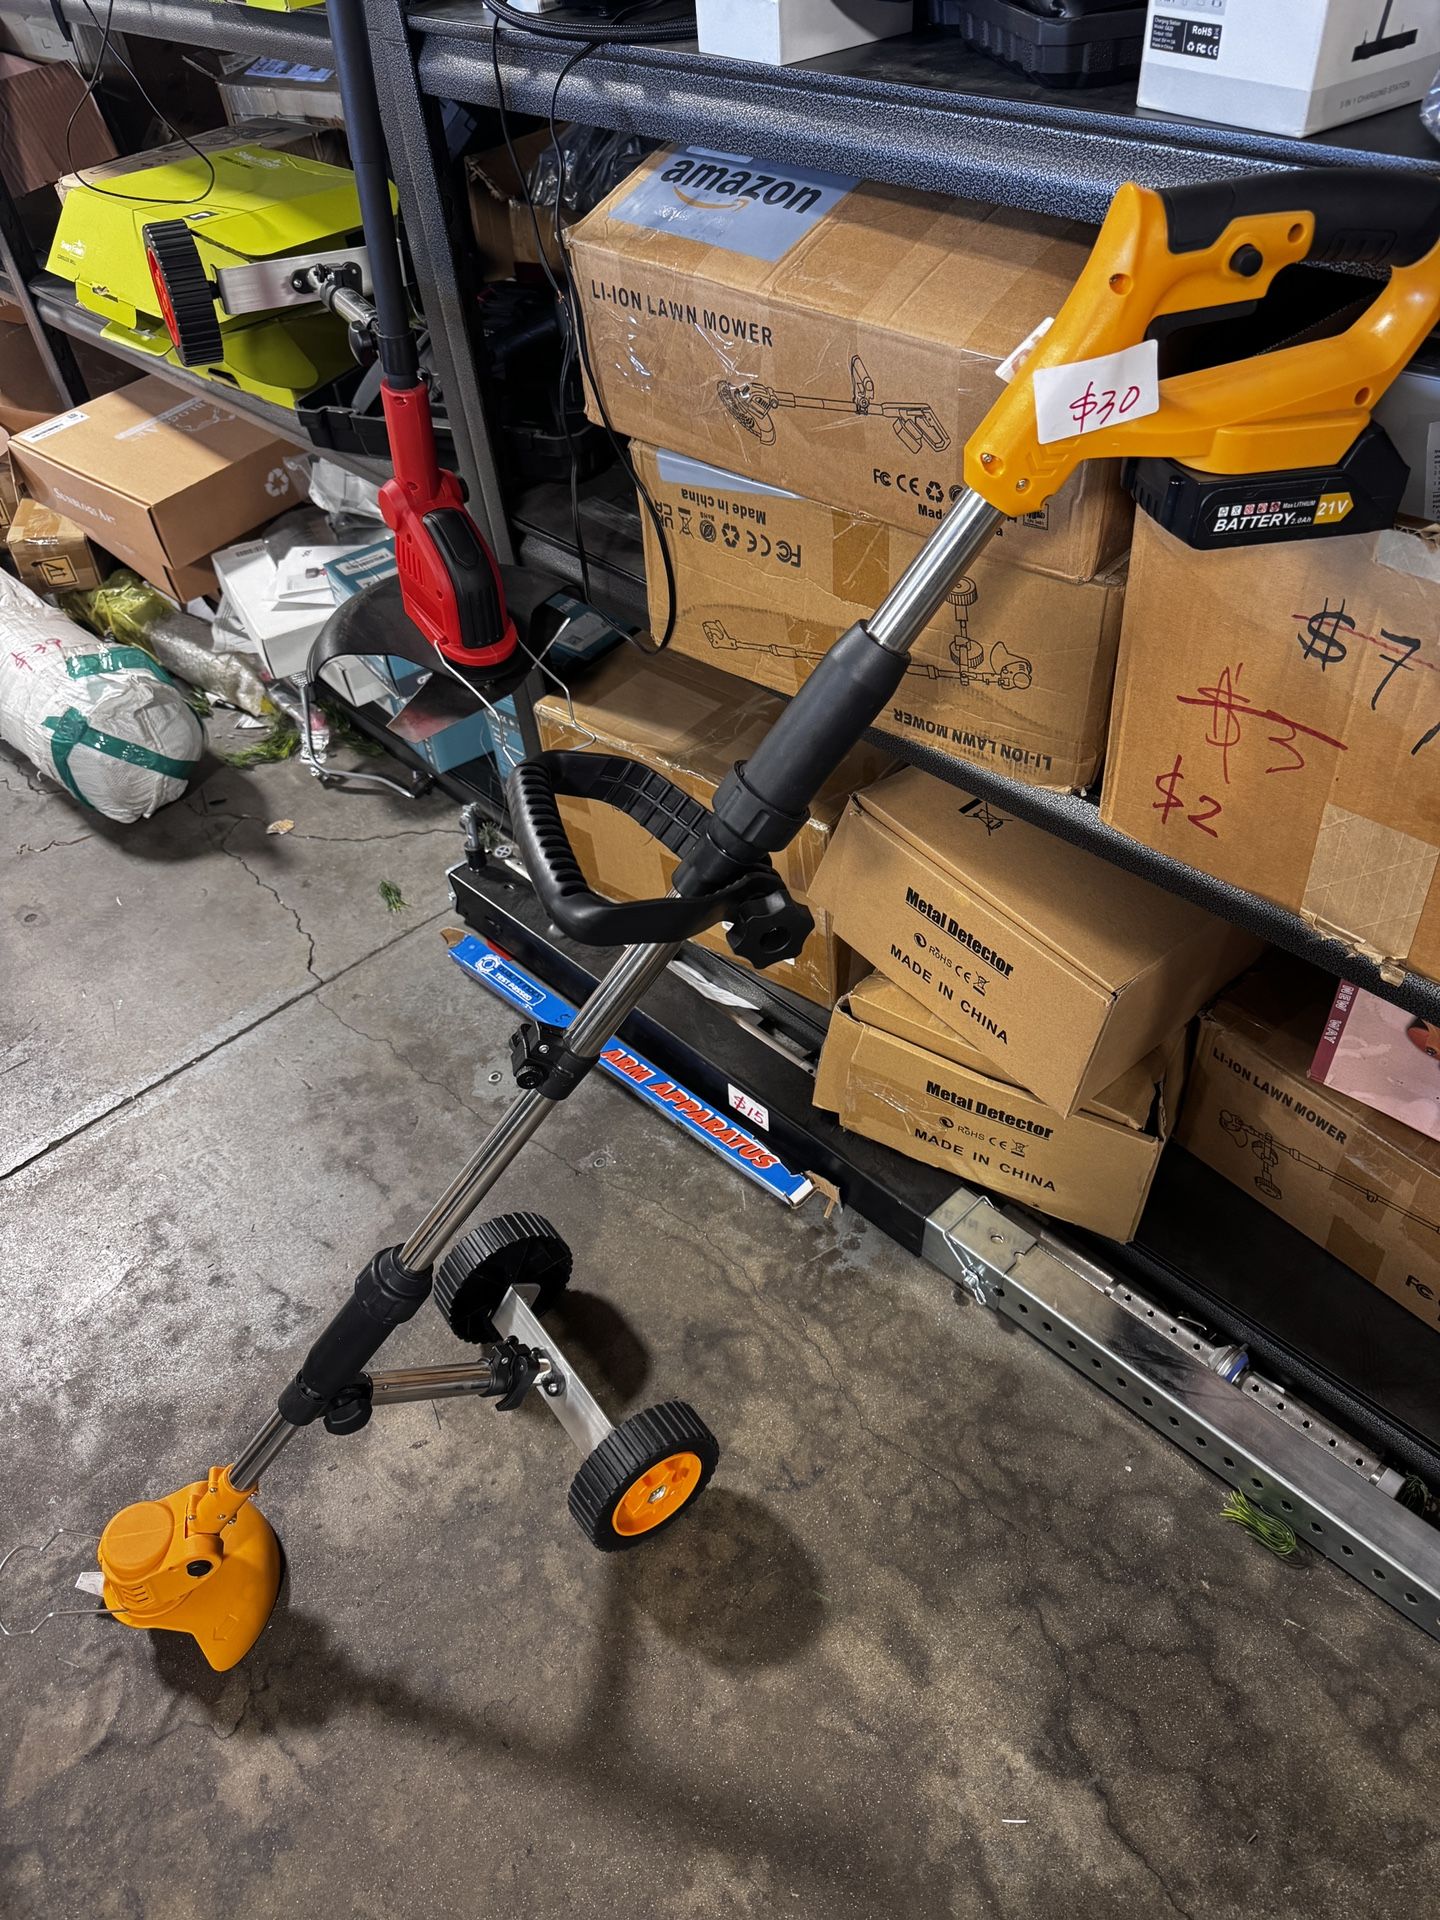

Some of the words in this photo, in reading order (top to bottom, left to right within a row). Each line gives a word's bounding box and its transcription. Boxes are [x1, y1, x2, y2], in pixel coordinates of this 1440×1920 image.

[1192, 25, 1213, 37] RoHS
[661, 160, 823, 214] amazon
[588, 280, 642, 312] LI-ION
[647, 295, 697, 325] LAWN
[703, 310, 773, 348] MOWER
[1069, 381, 1140, 433] $30
[873, 469, 892, 487] FC
[681, 488, 715, 508] china
[717, 498, 729, 512] in
[1294, 500, 1317, 509] LITHIUM
[1317, 500, 1349, 516] 21V
[731, 503, 766, 526] Made
[918, 504, 947, 521] Mad
[1213, 512, 1296, 533] BATTERY
[1290, 517, 1312, 525] 2.0Ah
[893, 708, 948, 738] MOWER
[952, 729, 996, 754] LAWN
[1000, 743, 1053, 770] LI-ION
[906, 886, 947, 928] Metal
[947, 917, 1014, 977] Detector
[929, 946, 953, 968] RoHS
[495, 971, 510, 986] TEST
[890, 944, 932, 984] MADE
[938, 981, 954, 1001] IN
[960, 1000, 1008, 1045] CHINA
[1335, 984, 1354, 1012] NEW
[1324, 1019, 1342, 1044] WAY
[1213, 1047, 1252, 1082] LI-ION
[1253, 1075, 1294, 1108] LAWN
[1294, 1102, 1348, 1145] MOWER
[601, 1048, 656, 1084] ARM
[646, 1080, 781, 1170] APPARATUS
[734, 1094, 764, 1125] $15
[926, 1080, 973, 1111] Metal
[975, 1102, 1054, 1139] Detector
[957, 1126, 986, 1142] RoHS
[915, 1128, 964, 1157] MADE
[972, 1152, 990, 1166] IN
[1000, 1163, 1056, 1193] CHINA
